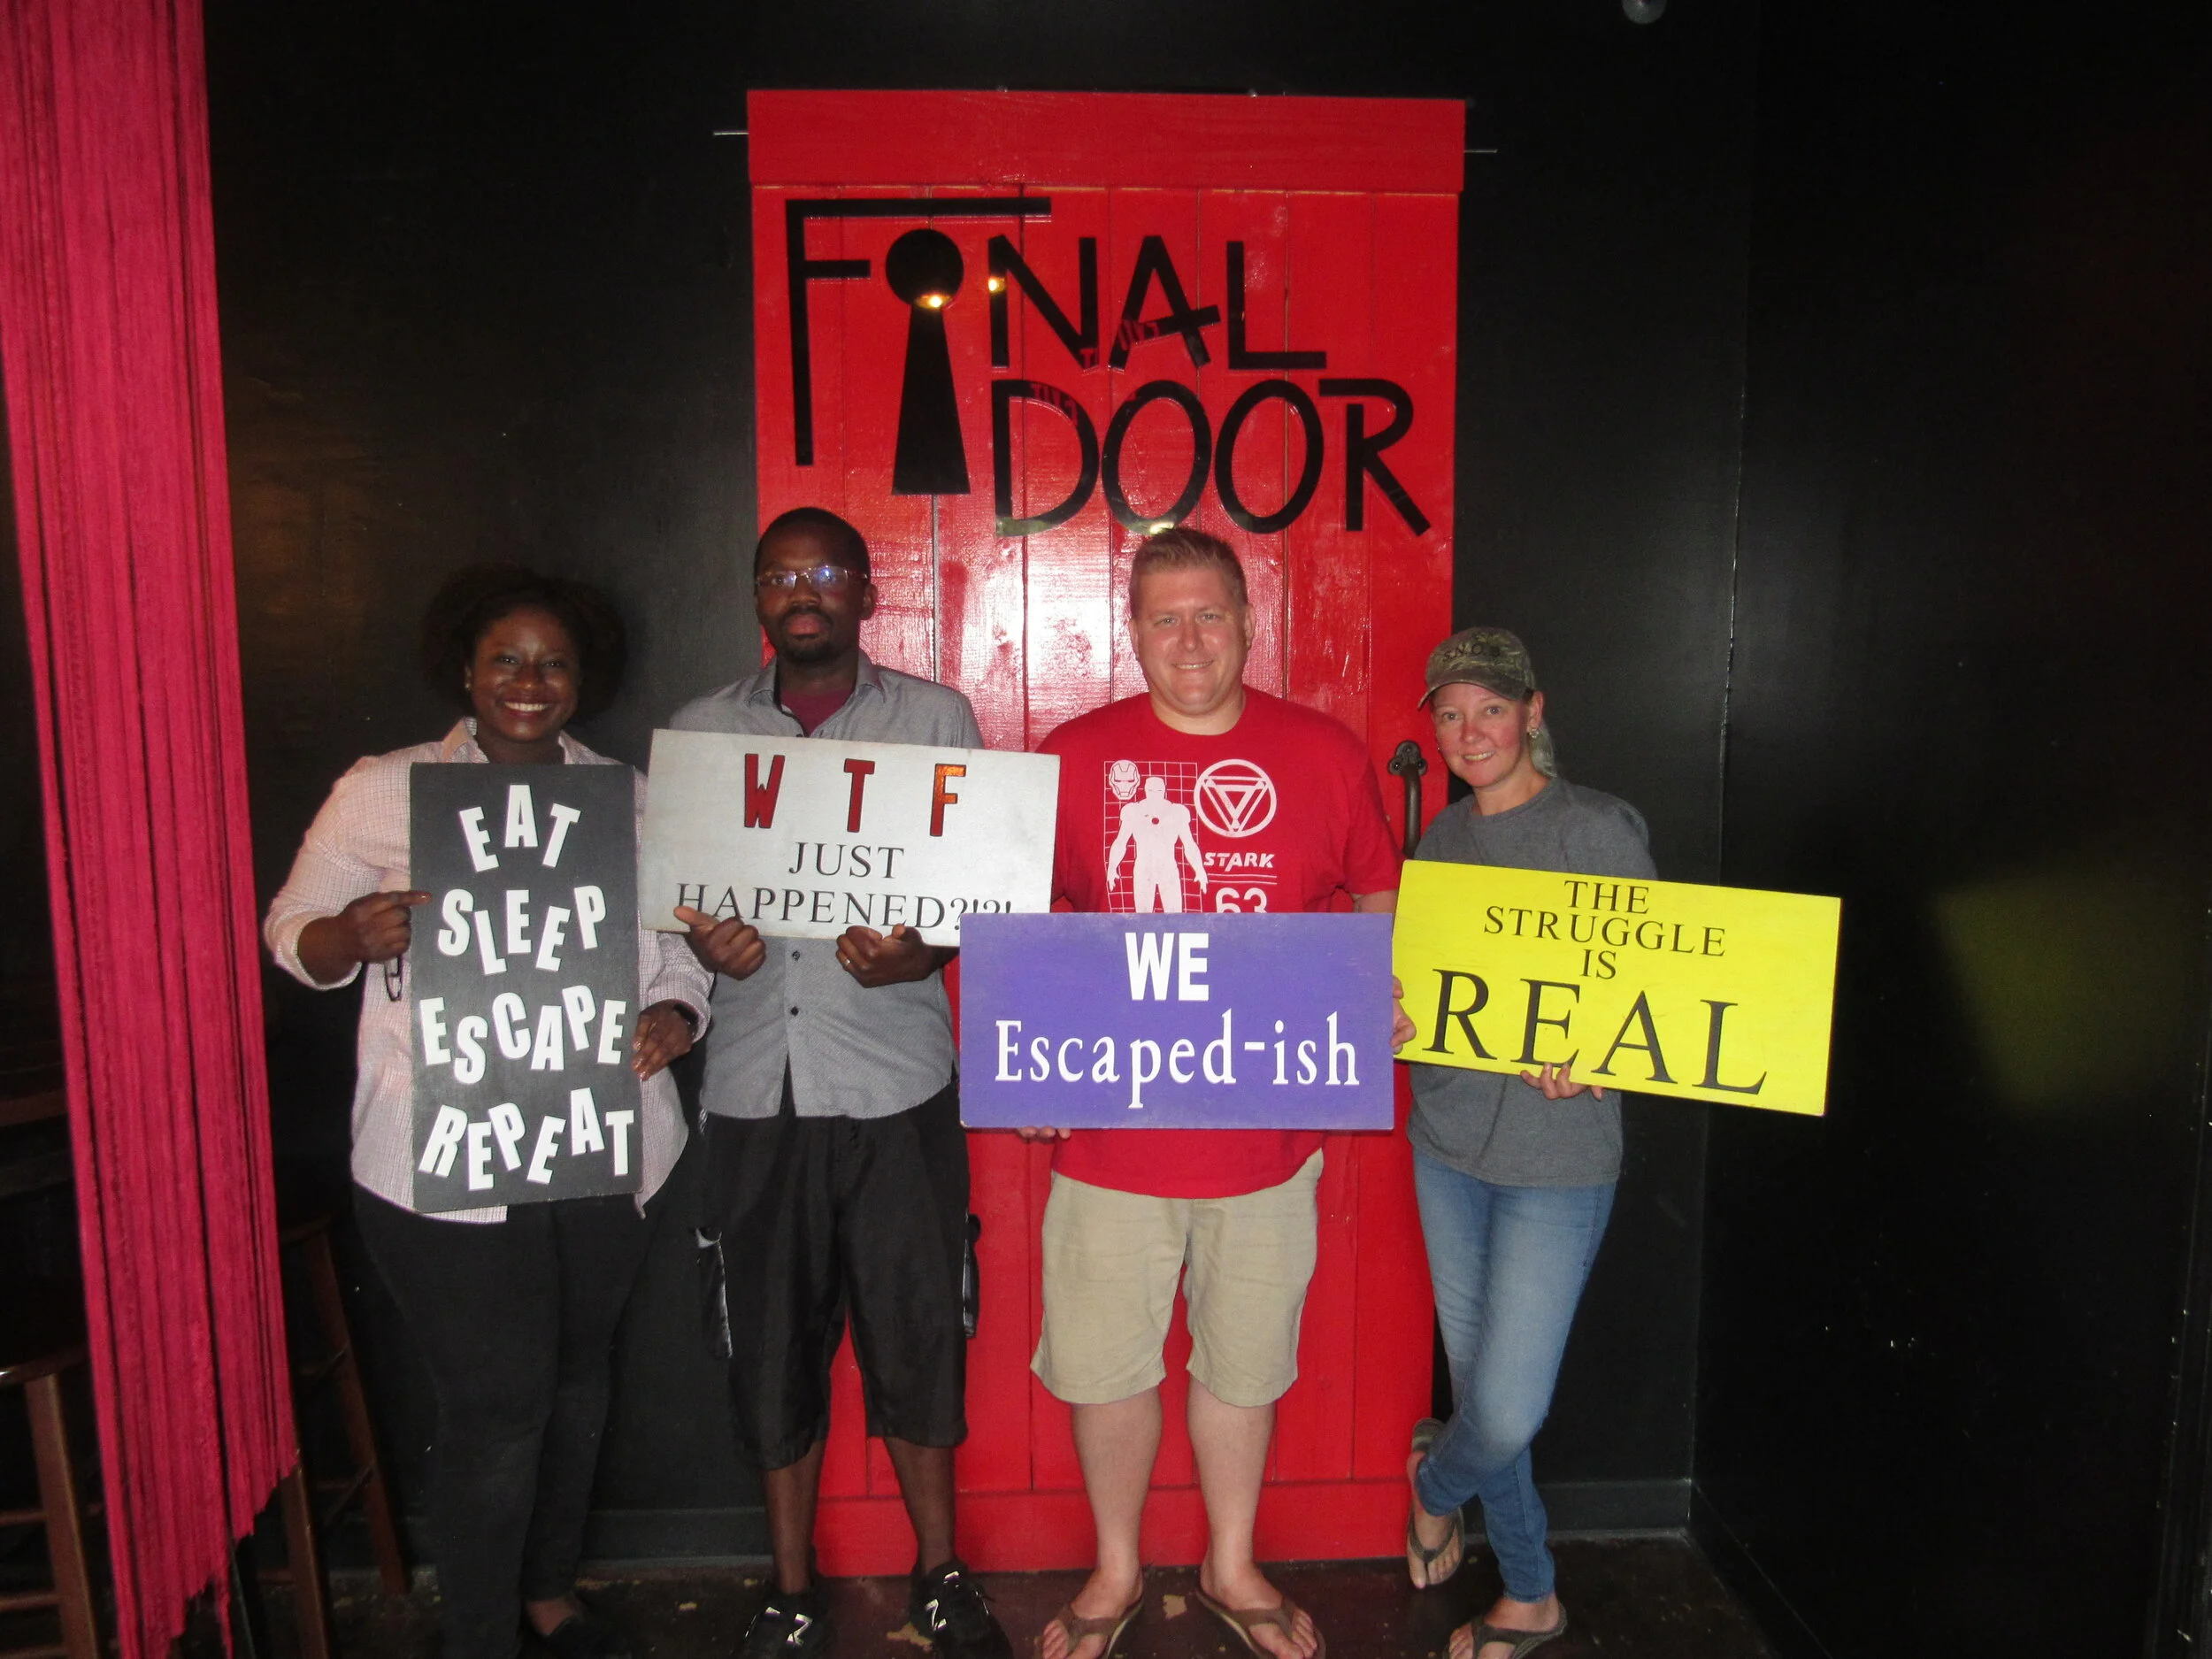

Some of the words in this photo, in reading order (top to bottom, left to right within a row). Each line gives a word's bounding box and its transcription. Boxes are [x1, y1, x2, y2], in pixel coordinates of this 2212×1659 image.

[785, 196, 1327, 495] FINAL
[992, 378, 1432, 537] DOOR
[459, 784, 581, 872] EAT
[788, 841, 905, 879] JUST
[1203, 852, 1276, 872] STARK
[437, 885, 607, 975] SLEEP
[1483, 904, 1726, 957] STRUGGLE
[1563, 879, 1650, 915] THE
[1125, 933, 1210, 1002] WE
[1578, 949, 1617, 979] IS
[419, 985, 627, 1085] ESCAPE
[995, 1008, 1360, 1109] Escaped-ish
[1422, 967, 1768, 1095] REAL
[418, 1087, 634, 1191] REPEAT
